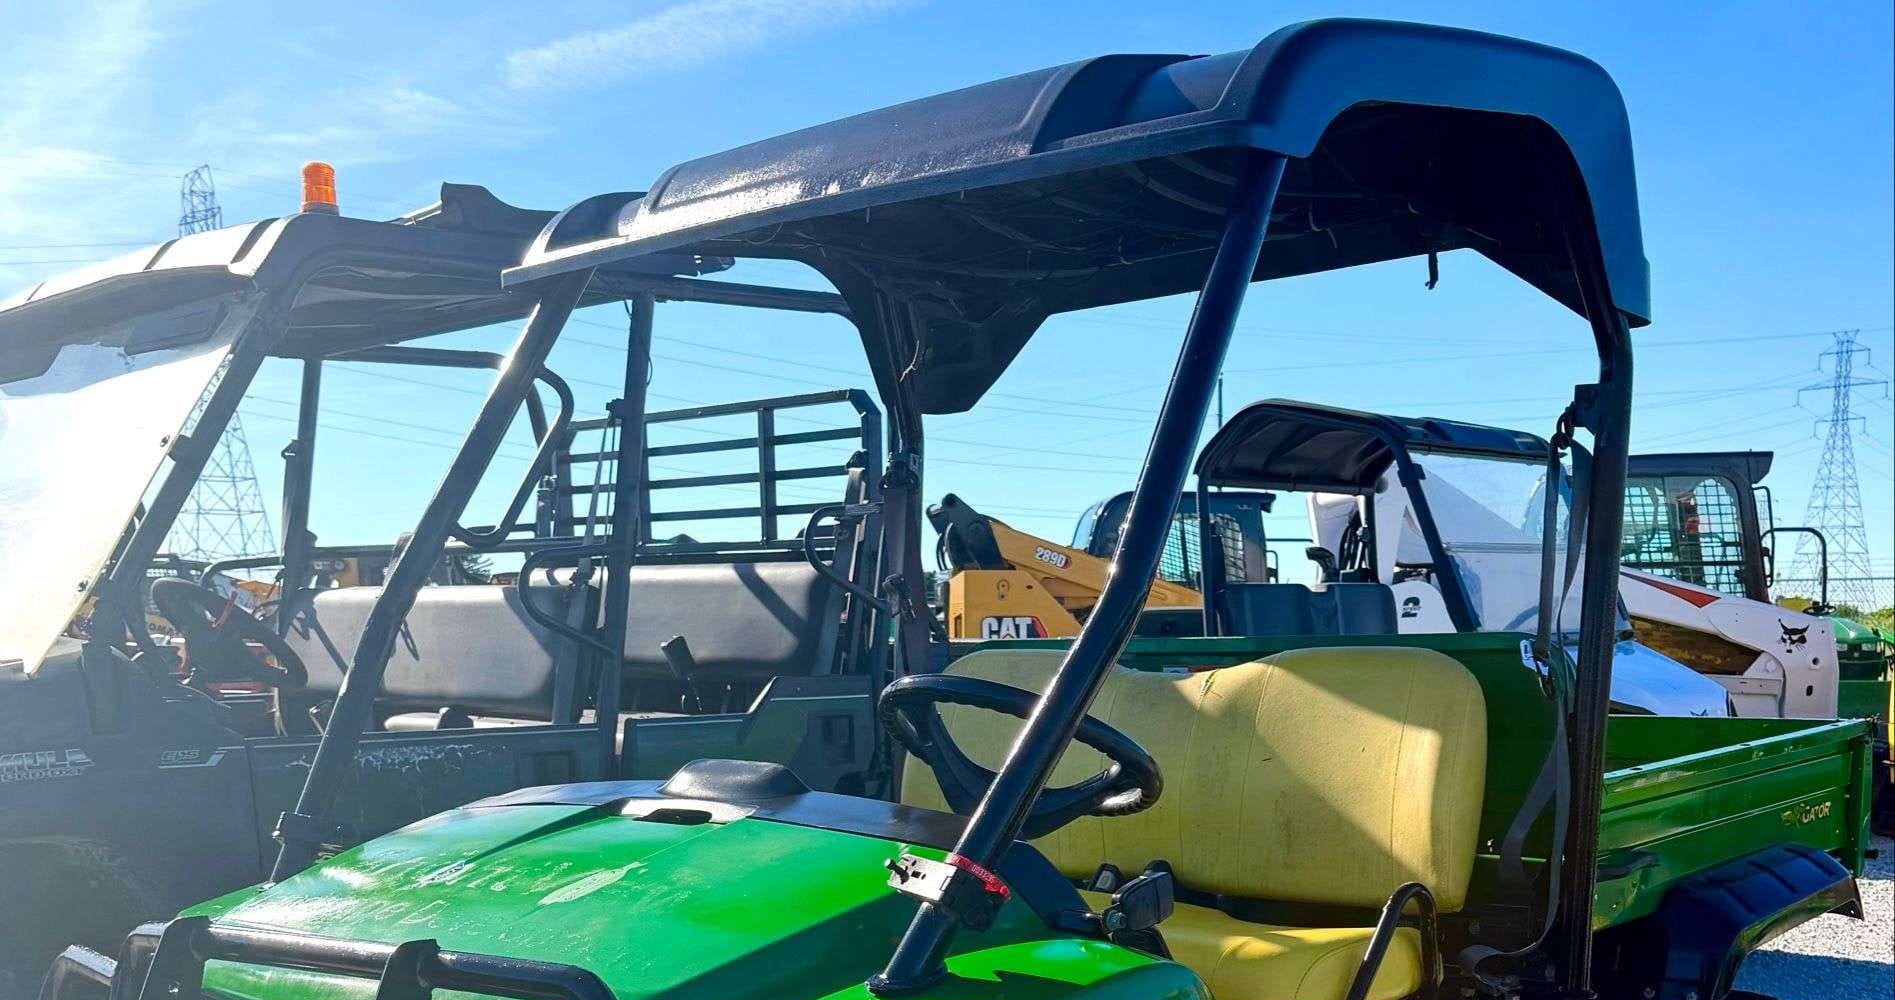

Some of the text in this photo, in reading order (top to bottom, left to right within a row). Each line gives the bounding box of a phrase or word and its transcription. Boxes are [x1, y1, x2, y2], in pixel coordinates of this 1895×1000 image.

[1034, 546, 1067, 568] 289D
[982, 617, 1032, 639] CAT
[1803, 802, 1831, 824] GATOR
